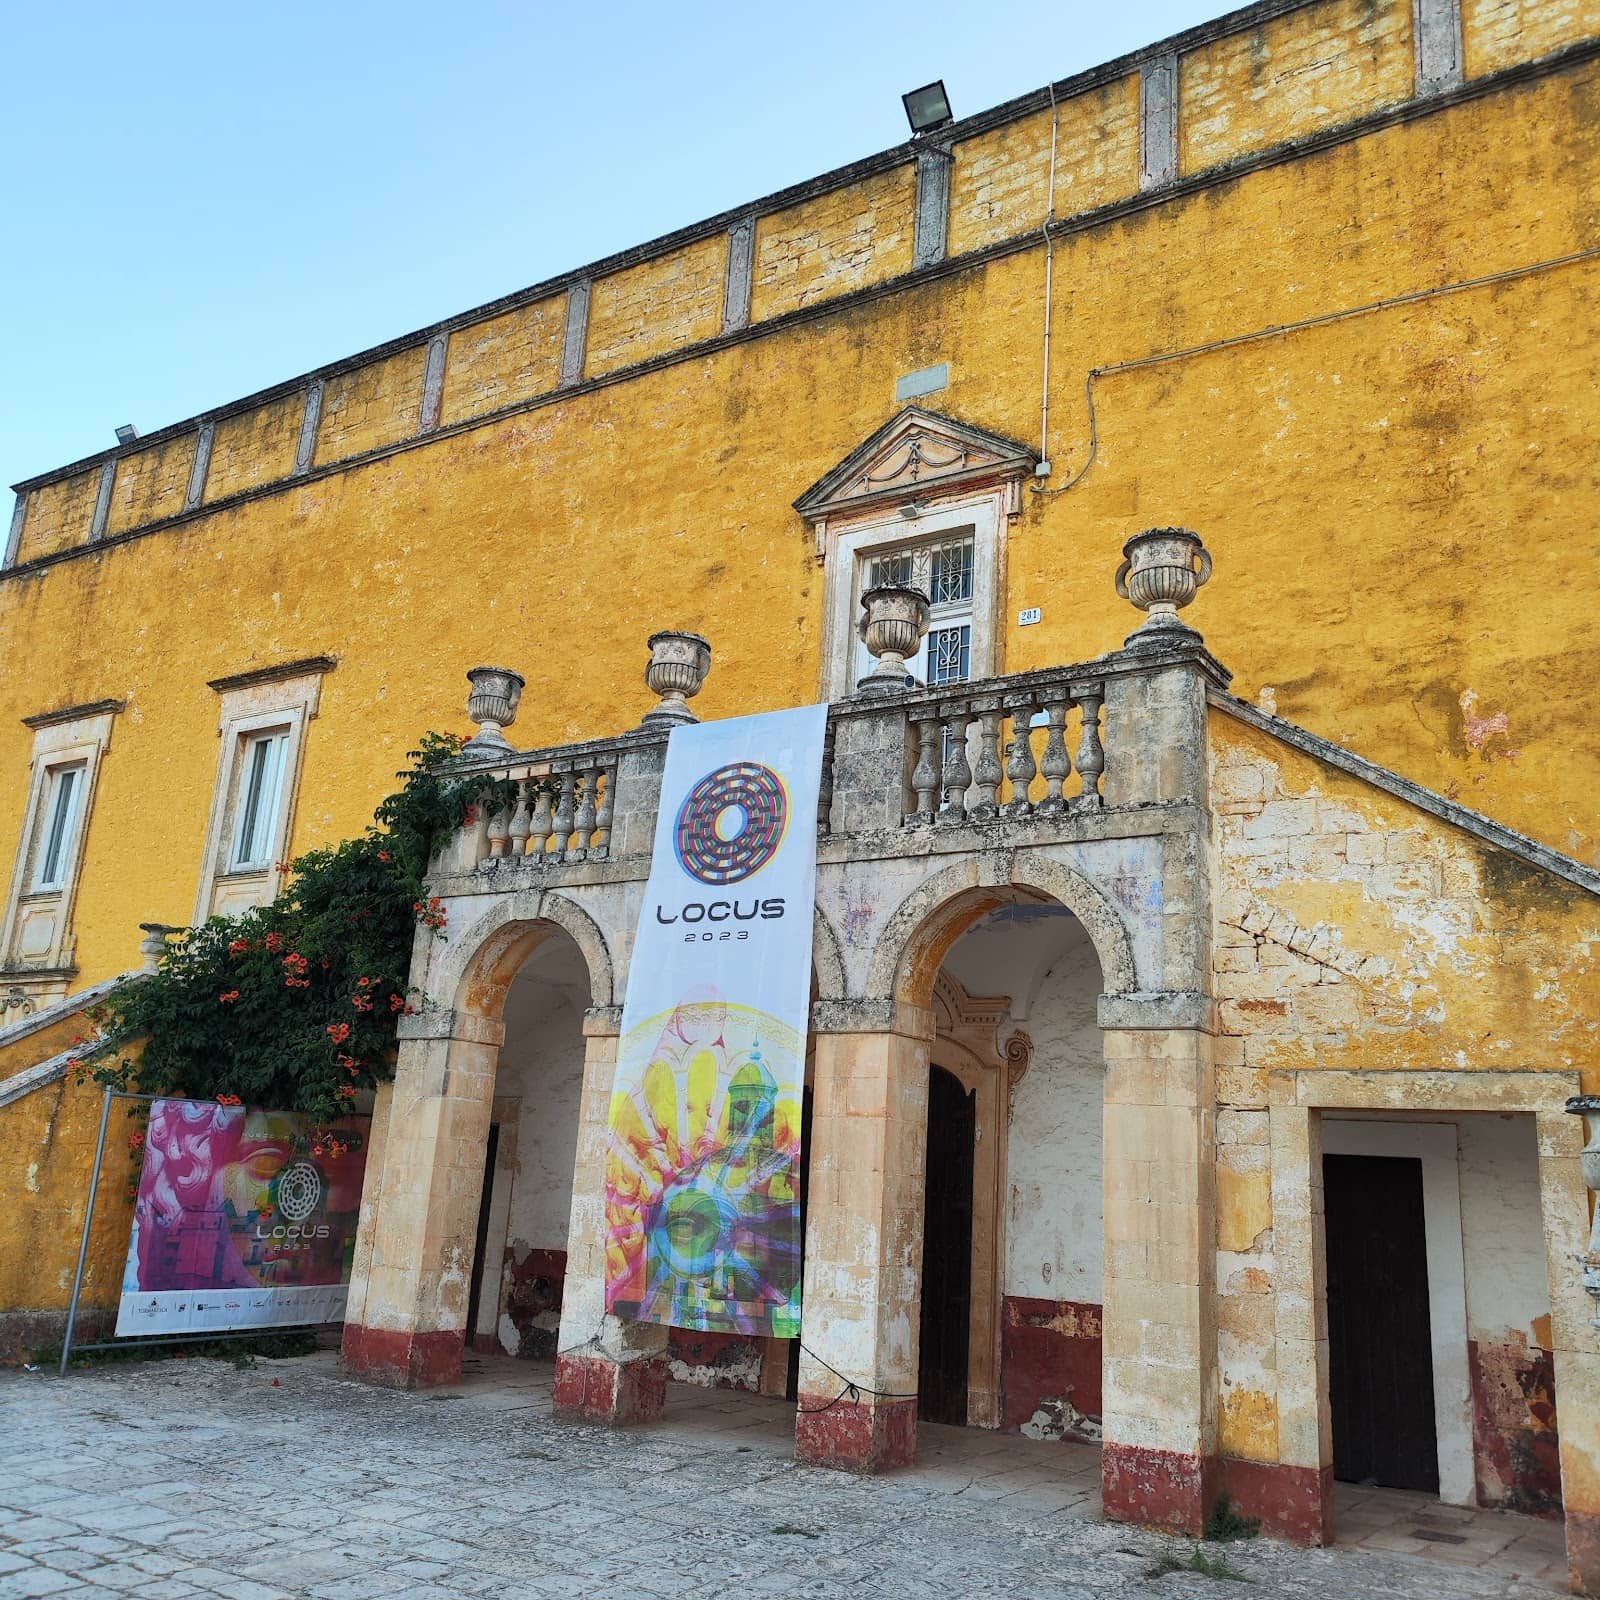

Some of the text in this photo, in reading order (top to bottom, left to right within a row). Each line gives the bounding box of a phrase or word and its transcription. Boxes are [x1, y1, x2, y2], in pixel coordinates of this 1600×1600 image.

[656, 898, 786, 924] LOCUS
[684, 930, 749, 942] 2023
[256, 1225, 330, 1239] LOCUS
